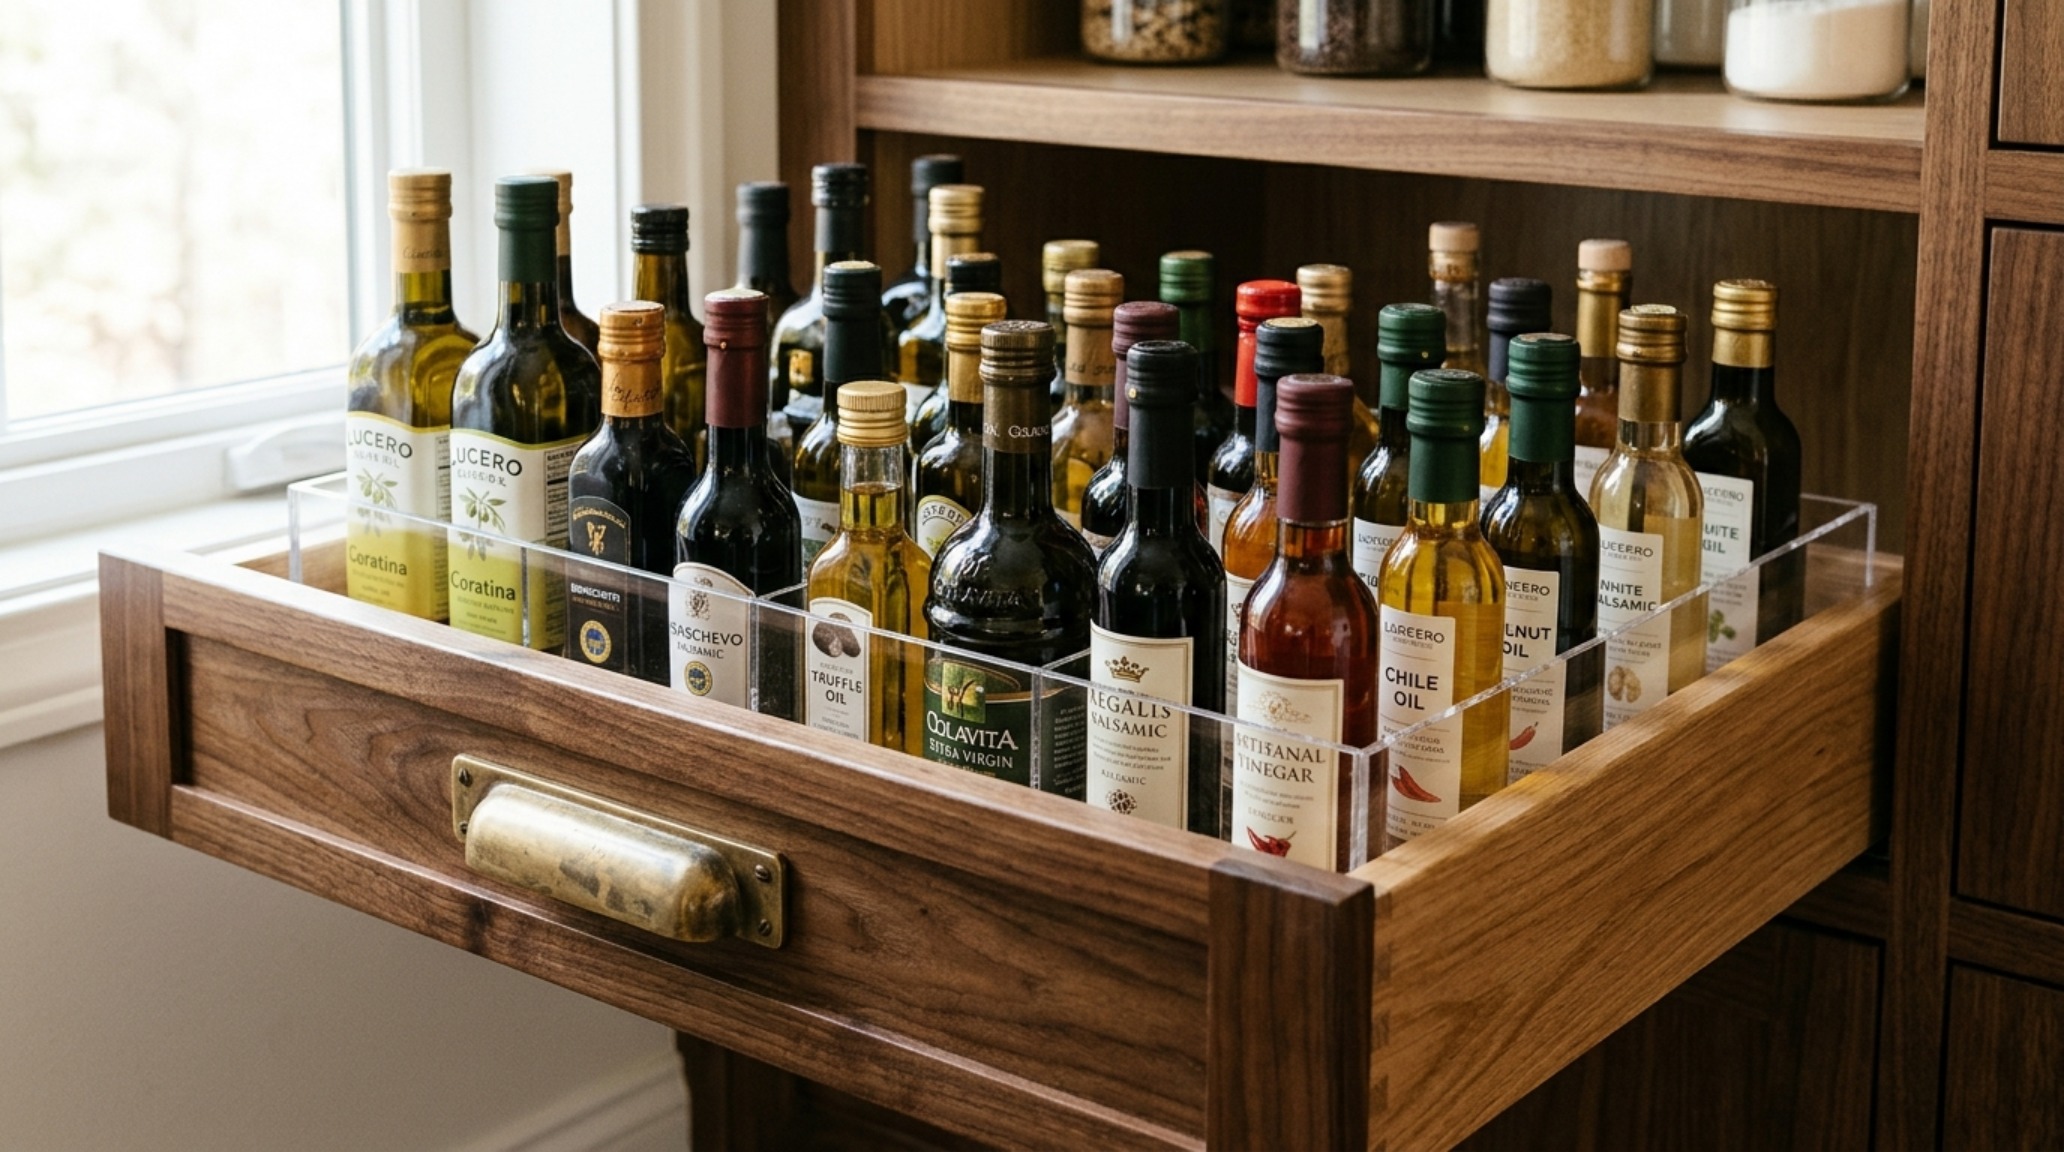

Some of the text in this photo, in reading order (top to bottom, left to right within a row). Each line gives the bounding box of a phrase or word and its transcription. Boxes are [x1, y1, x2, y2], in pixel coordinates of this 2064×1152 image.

[349, 545, 408, 576] Coratina
[450, 570, 516, 601] Coratina
[669, 622, 743, 646] SASCHEVO
[1502, 641, 1529, 658] OIL
[1385, 666, 1439, 691] CHILE
[825, 689, 847, 705] OIL
[1394, 691, 1425, 710] OIL
[962, 749, 1013, 769] VIRGIN
